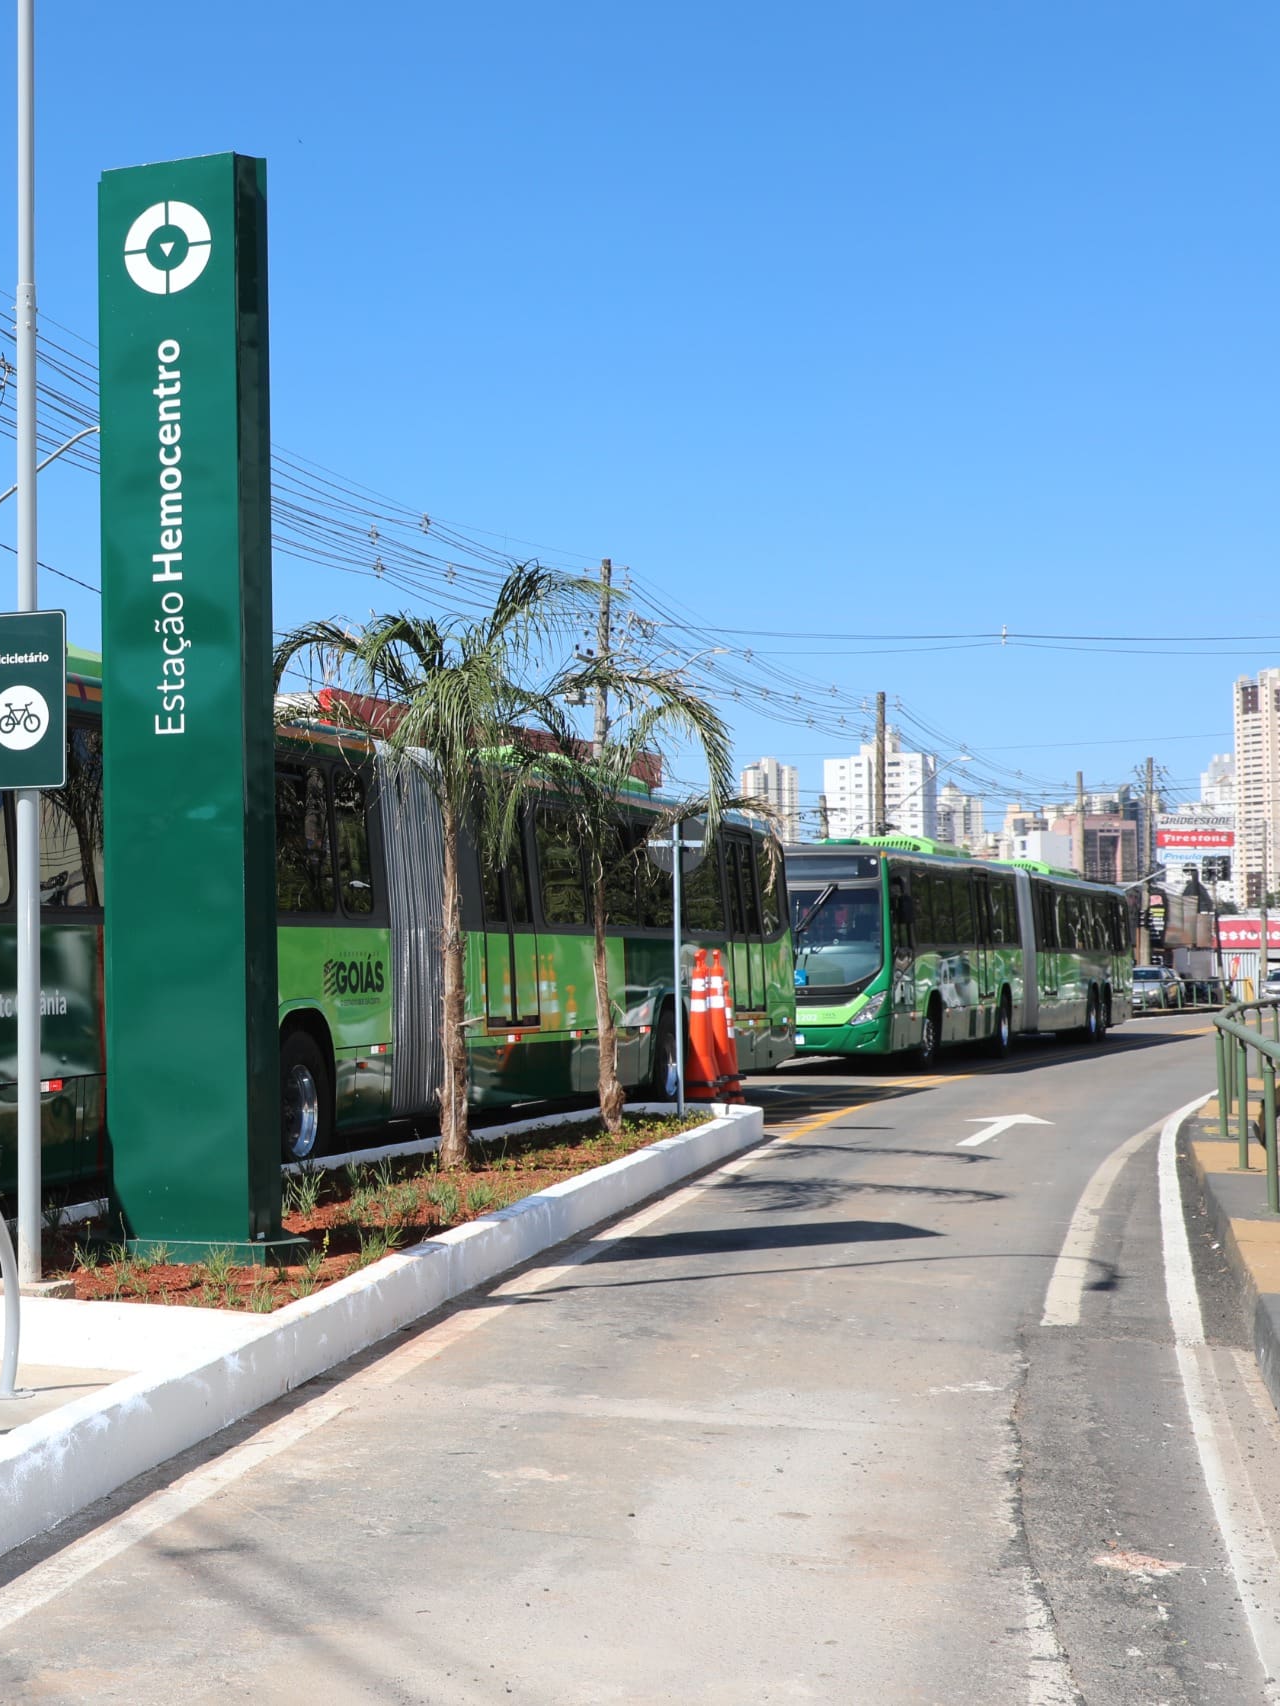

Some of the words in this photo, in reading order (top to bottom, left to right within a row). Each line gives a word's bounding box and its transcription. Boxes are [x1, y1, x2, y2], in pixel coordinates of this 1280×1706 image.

[152, 338, 184, 583] Hemocentro
[154, 591, 192, 735] Estação
[1161, 815, 1233, 825] BRIDGESTONE
[1163, 834, 1229, 843] Firestone
[335, 953, 385, 995] GOIÁS
